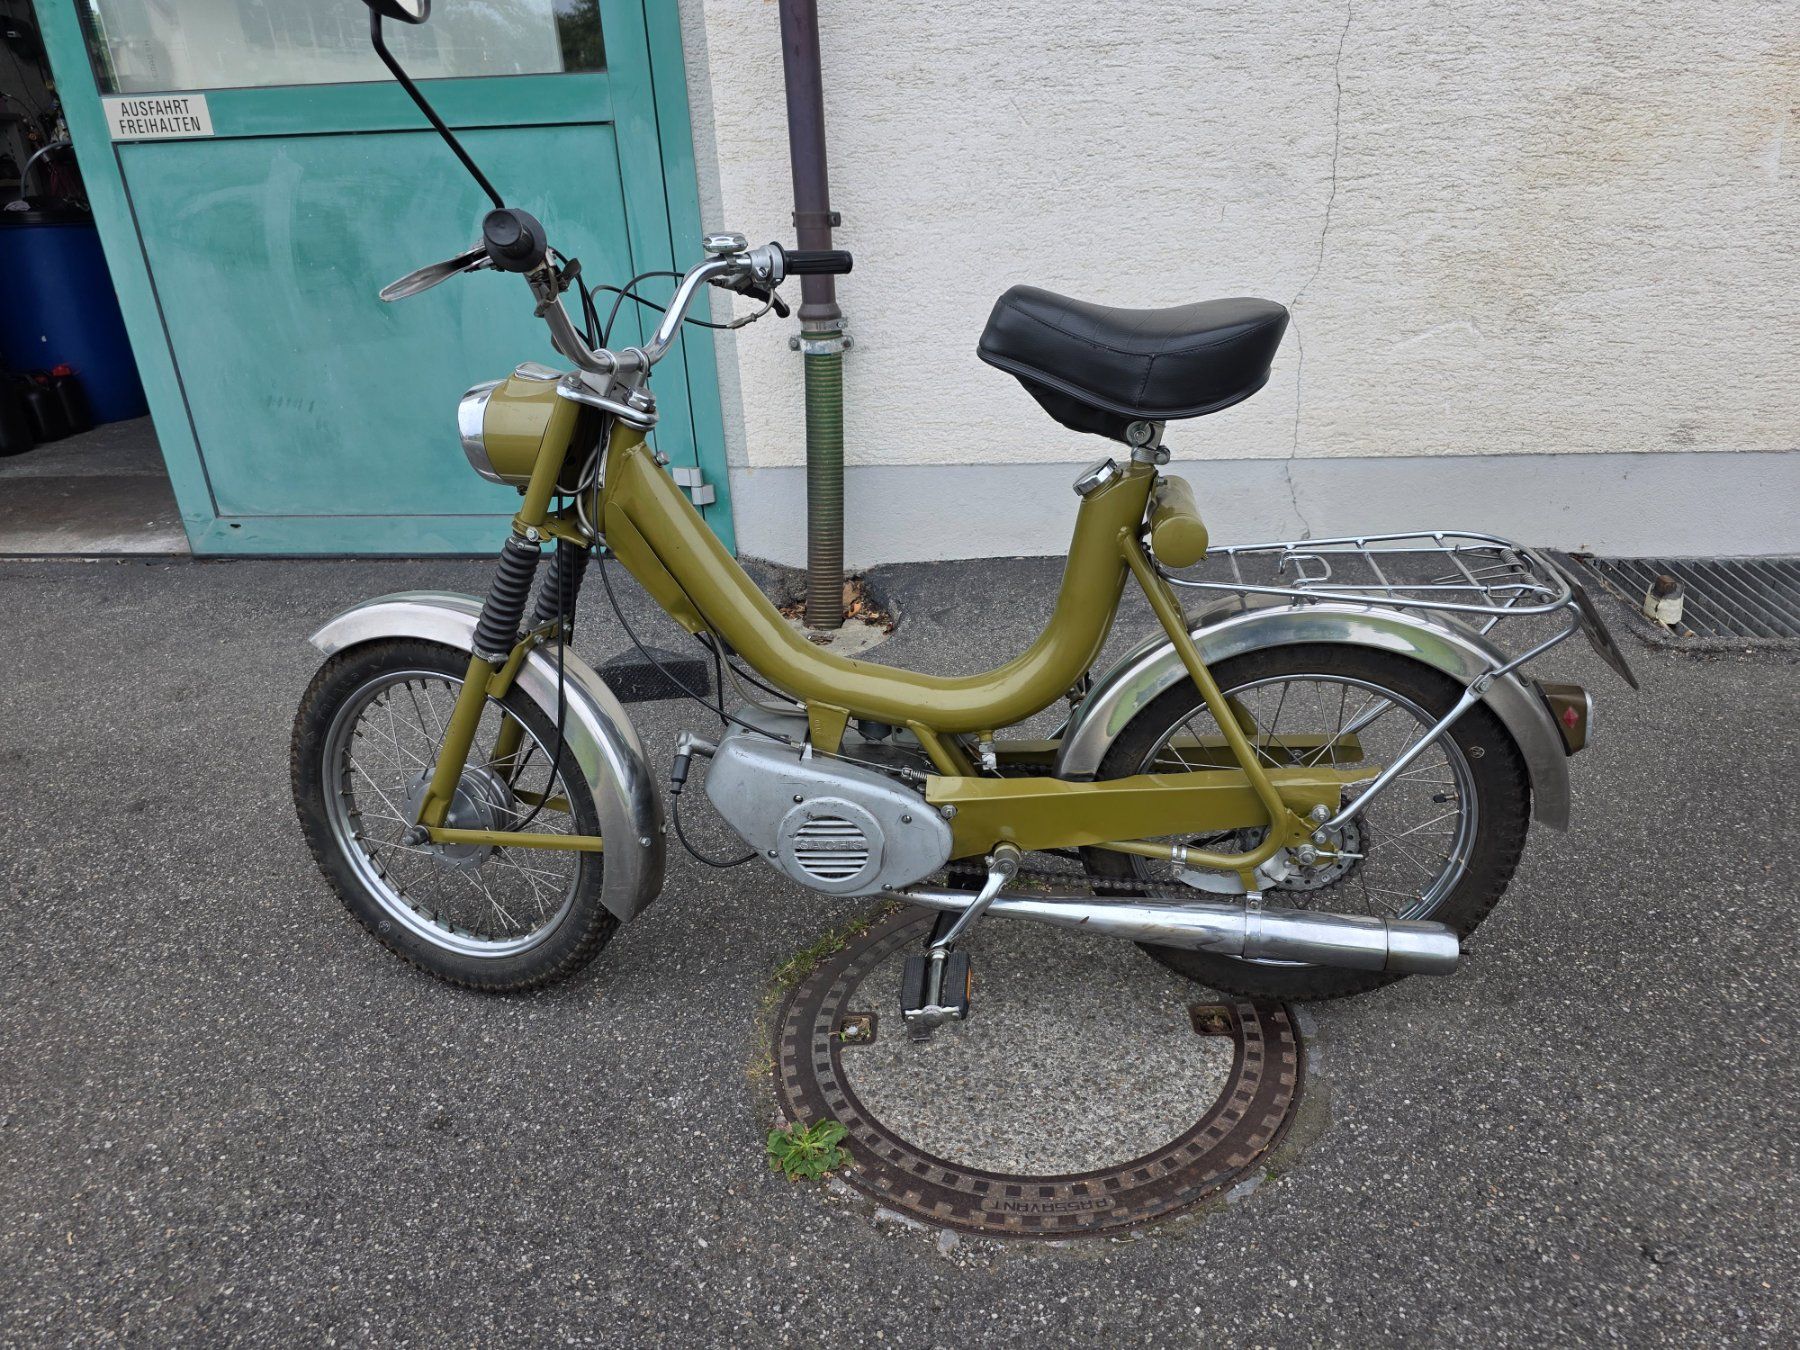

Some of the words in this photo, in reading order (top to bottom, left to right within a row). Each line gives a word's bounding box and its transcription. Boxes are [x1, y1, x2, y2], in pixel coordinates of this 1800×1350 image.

[121, 99, 189, 117] AUSFAHRT
[120, 116, 201, 134] FREIHALTEN
[799, 839, 863, 850] SACHS
[992, 1197, 1109, 1212] PASSAVANT
